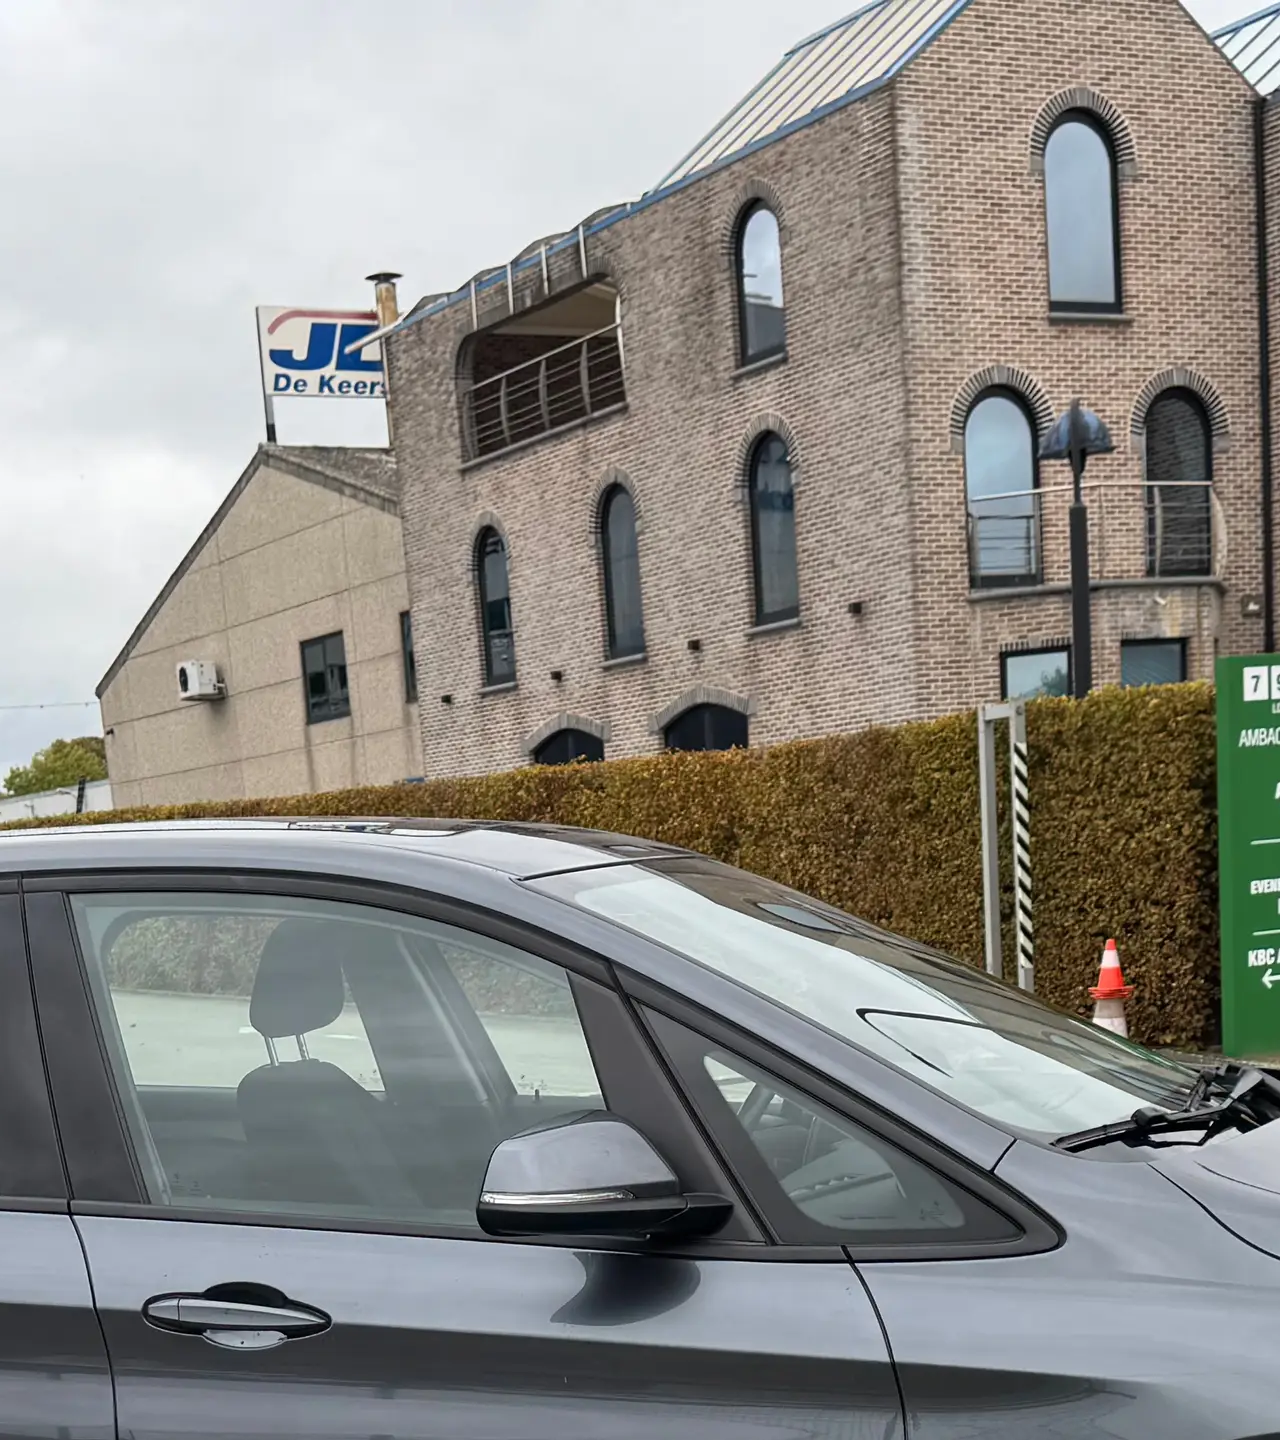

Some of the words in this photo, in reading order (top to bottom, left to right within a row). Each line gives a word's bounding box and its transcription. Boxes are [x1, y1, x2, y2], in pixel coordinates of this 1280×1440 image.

[273, 373, 308, 393] De
[1250, 674, 1261, 693] 7
[1248, 948, 1276, 967] KBC
